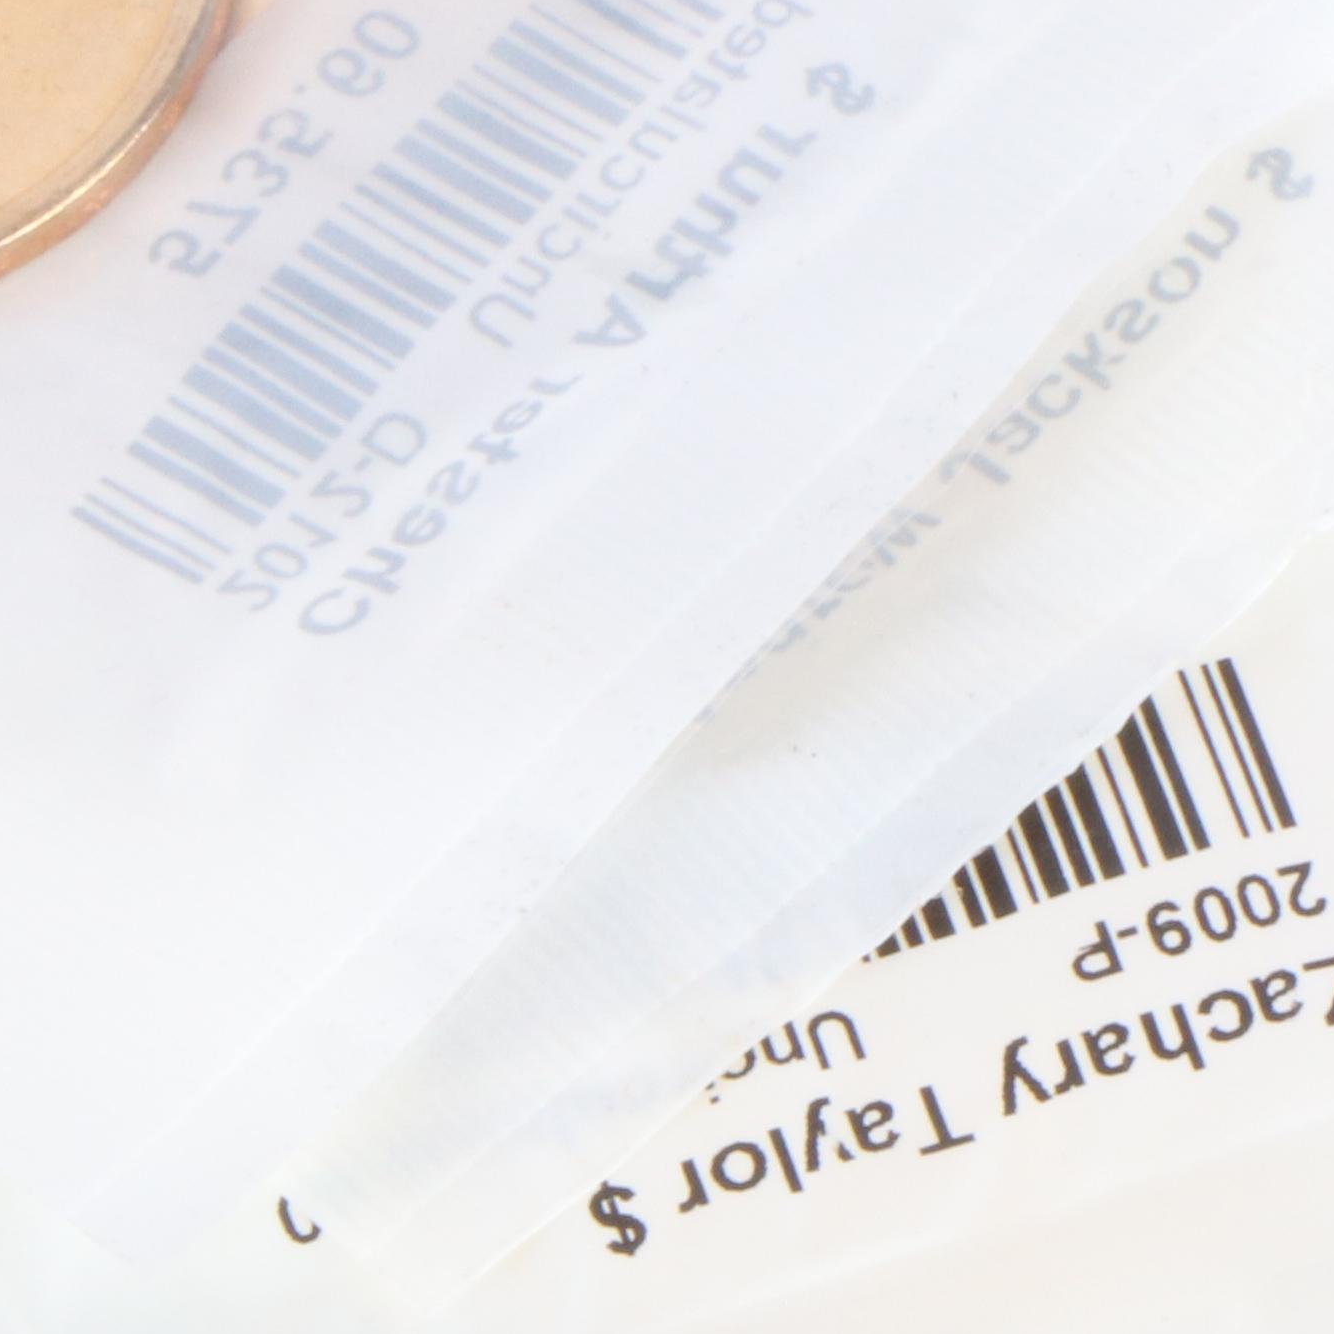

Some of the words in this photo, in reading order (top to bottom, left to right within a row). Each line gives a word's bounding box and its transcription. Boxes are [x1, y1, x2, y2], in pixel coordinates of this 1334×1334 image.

[1071, 860, 1329, 982] 2009-P
[678, 1084, 974, 1215] Taylor
[588, 1180, 648, 1257] $
